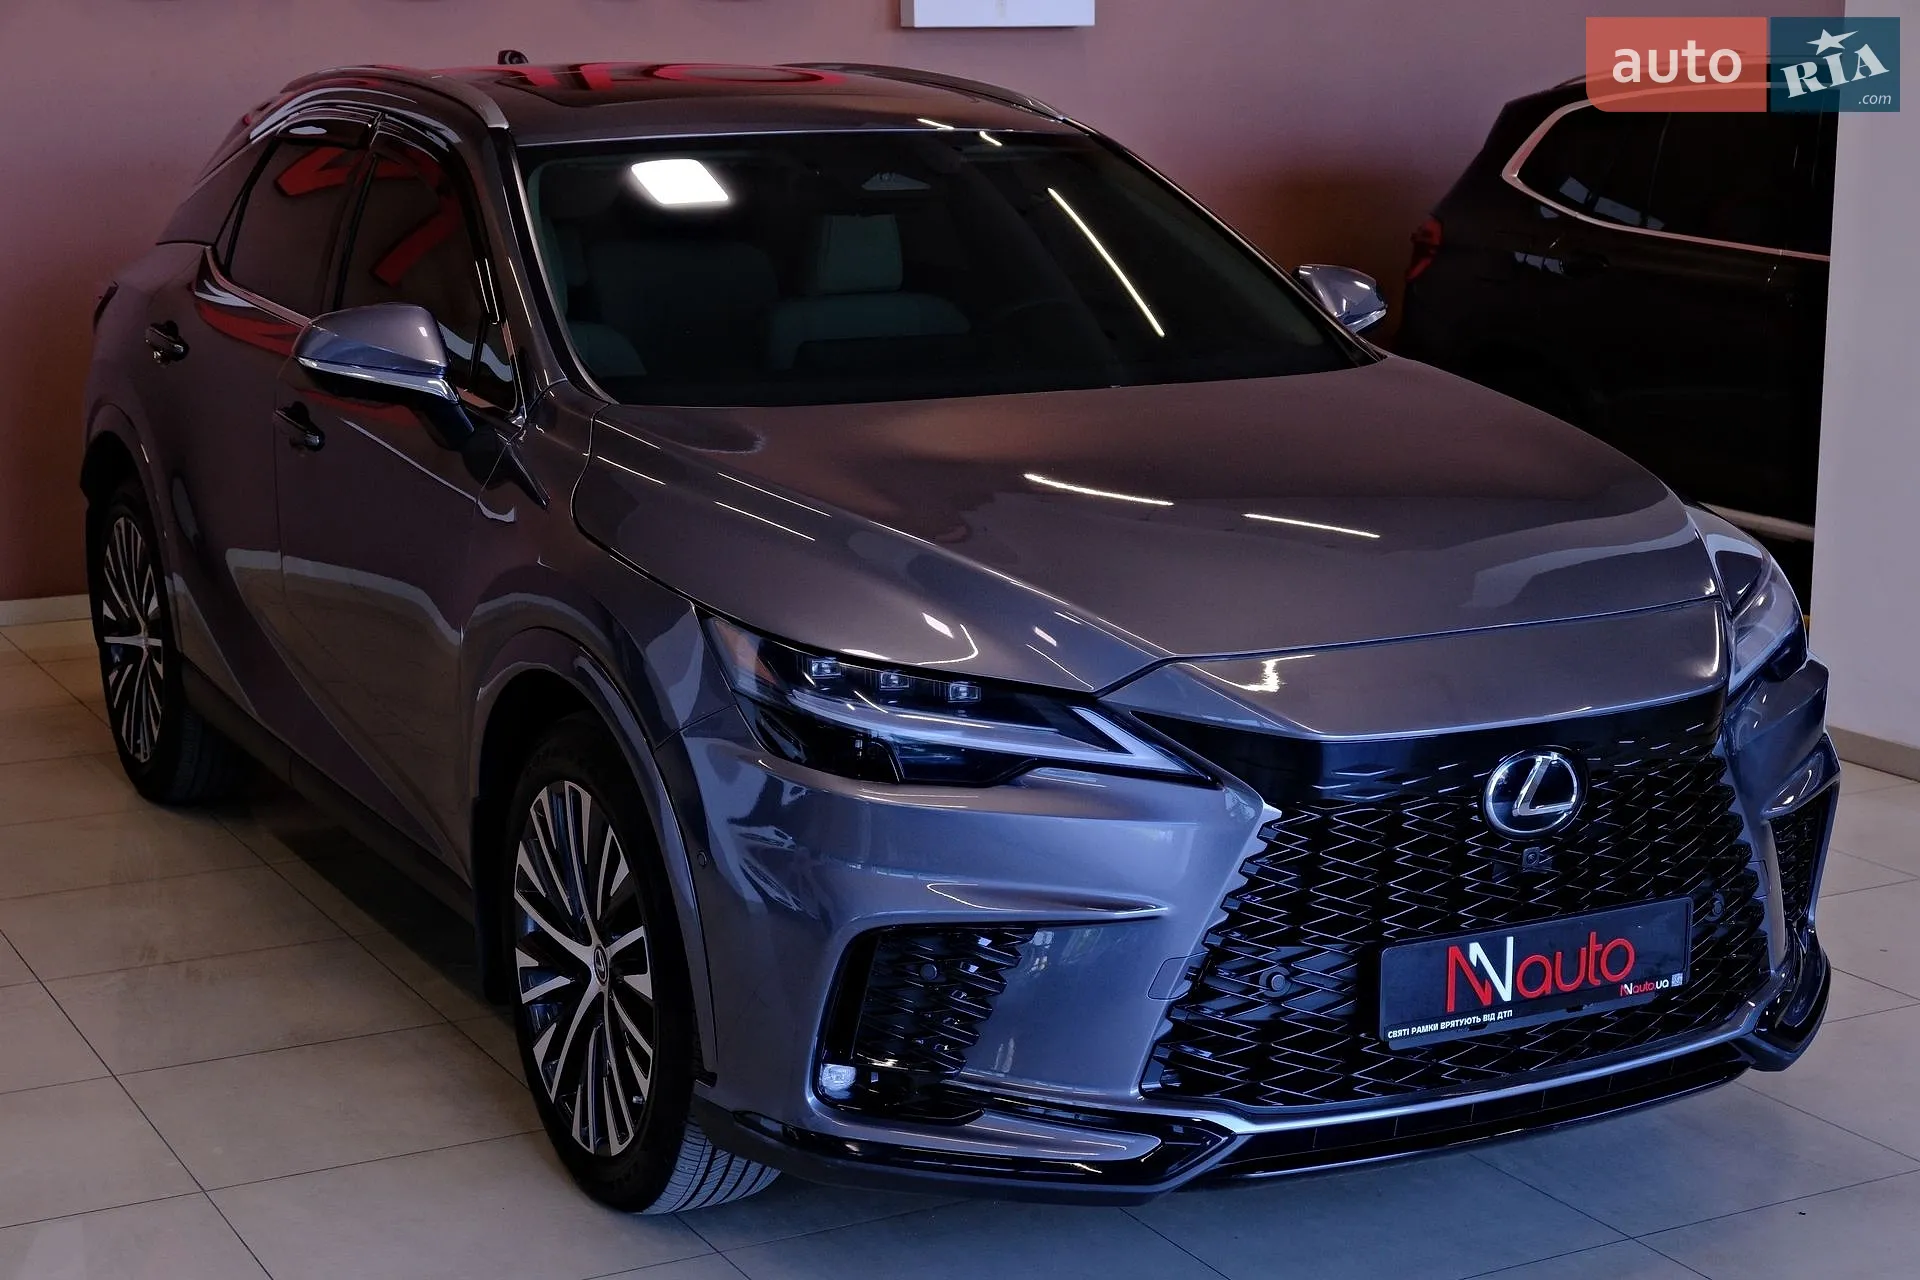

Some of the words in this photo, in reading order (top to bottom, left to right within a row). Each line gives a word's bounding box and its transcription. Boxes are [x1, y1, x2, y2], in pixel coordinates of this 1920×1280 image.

[1387, 1028, 1410, 1039] СВЯТІ
[1411, 1023, 1439, 1034] РАМКИ
[1440, 1016, 1481, 1030] ВРЯТУЮТЬ
[1483, 1013, 1496, 1022] ВІД
[1497, 1009, 1513, 1020] ДТП
